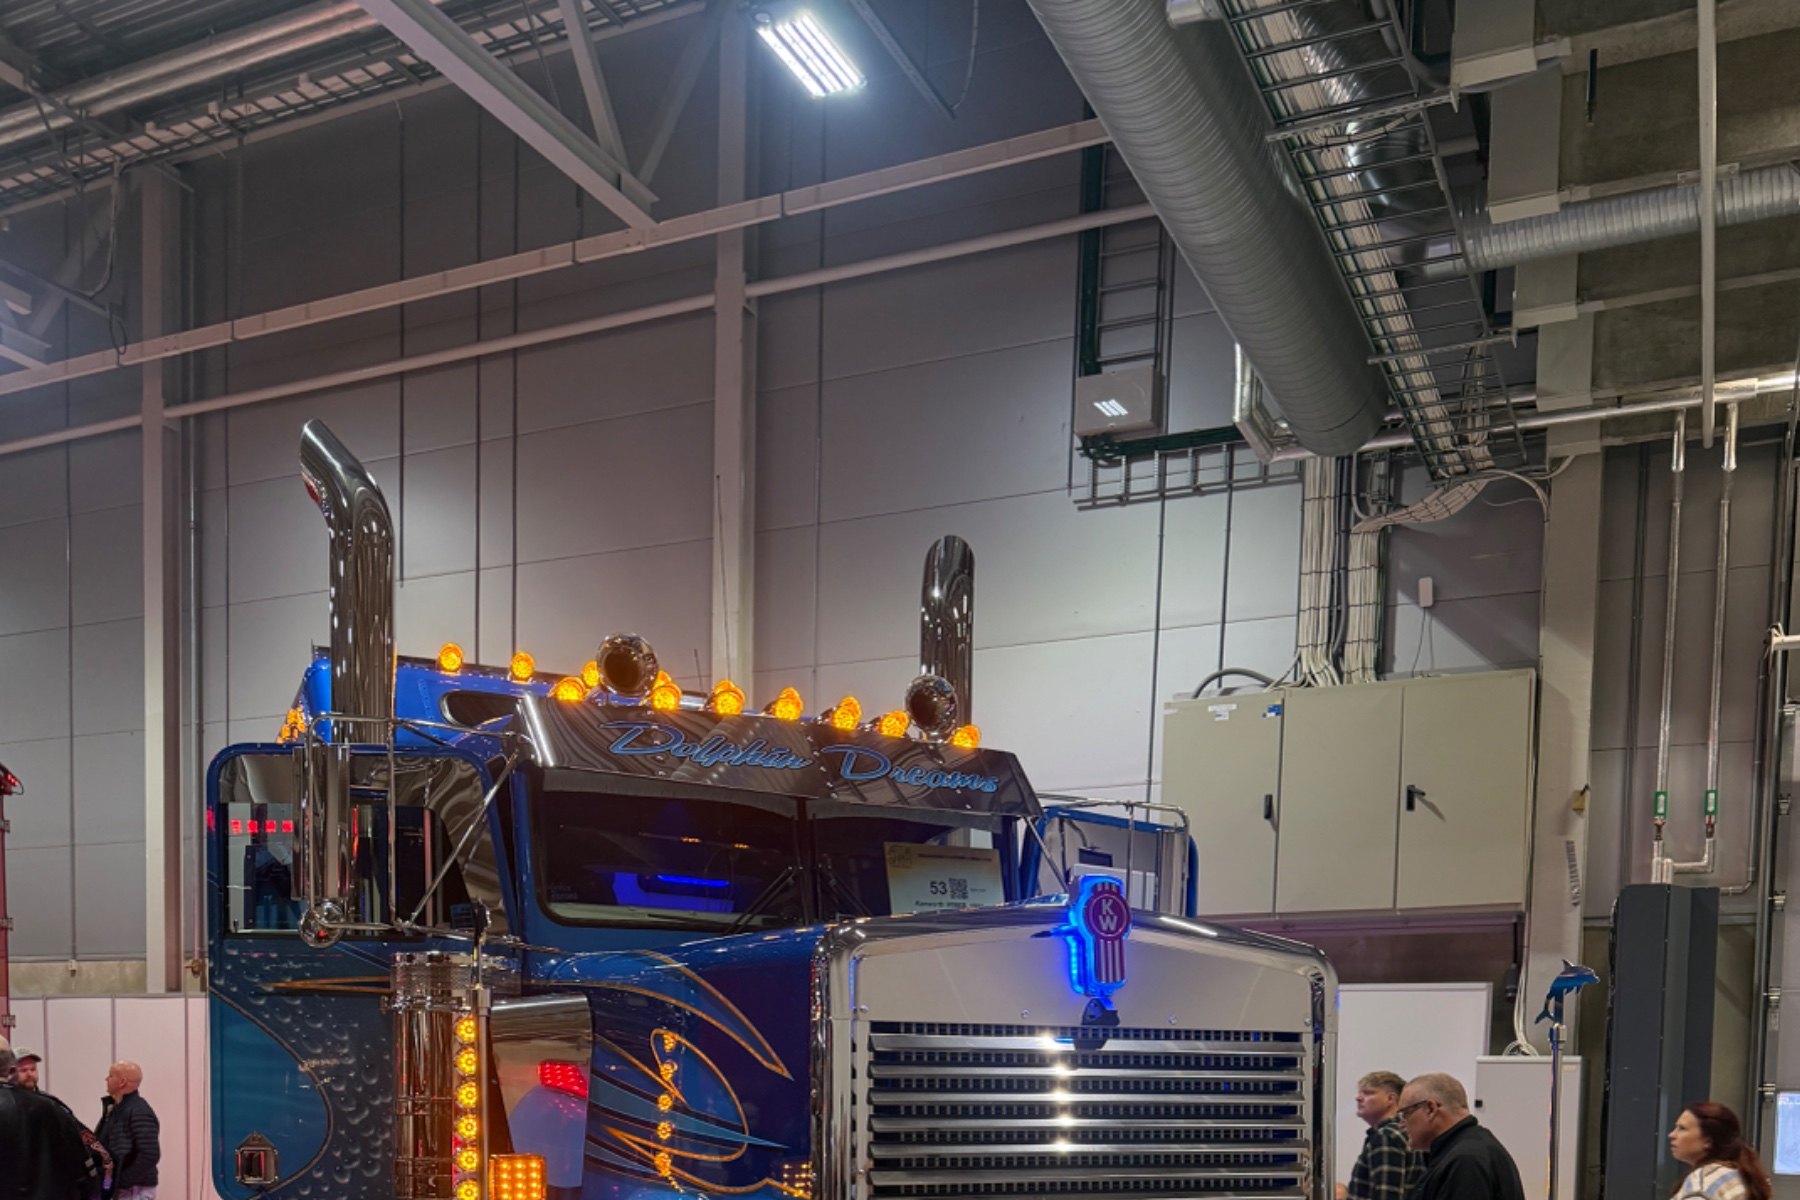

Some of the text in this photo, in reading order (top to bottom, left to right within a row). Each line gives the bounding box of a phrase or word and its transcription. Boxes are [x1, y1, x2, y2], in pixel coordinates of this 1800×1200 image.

[601, 721, 998, 793] Dolphin Dreams
[929, 881, 948, 895] 53
[1101, 898, 1114, 915] K
[1098, 914, 1118, 931] W
